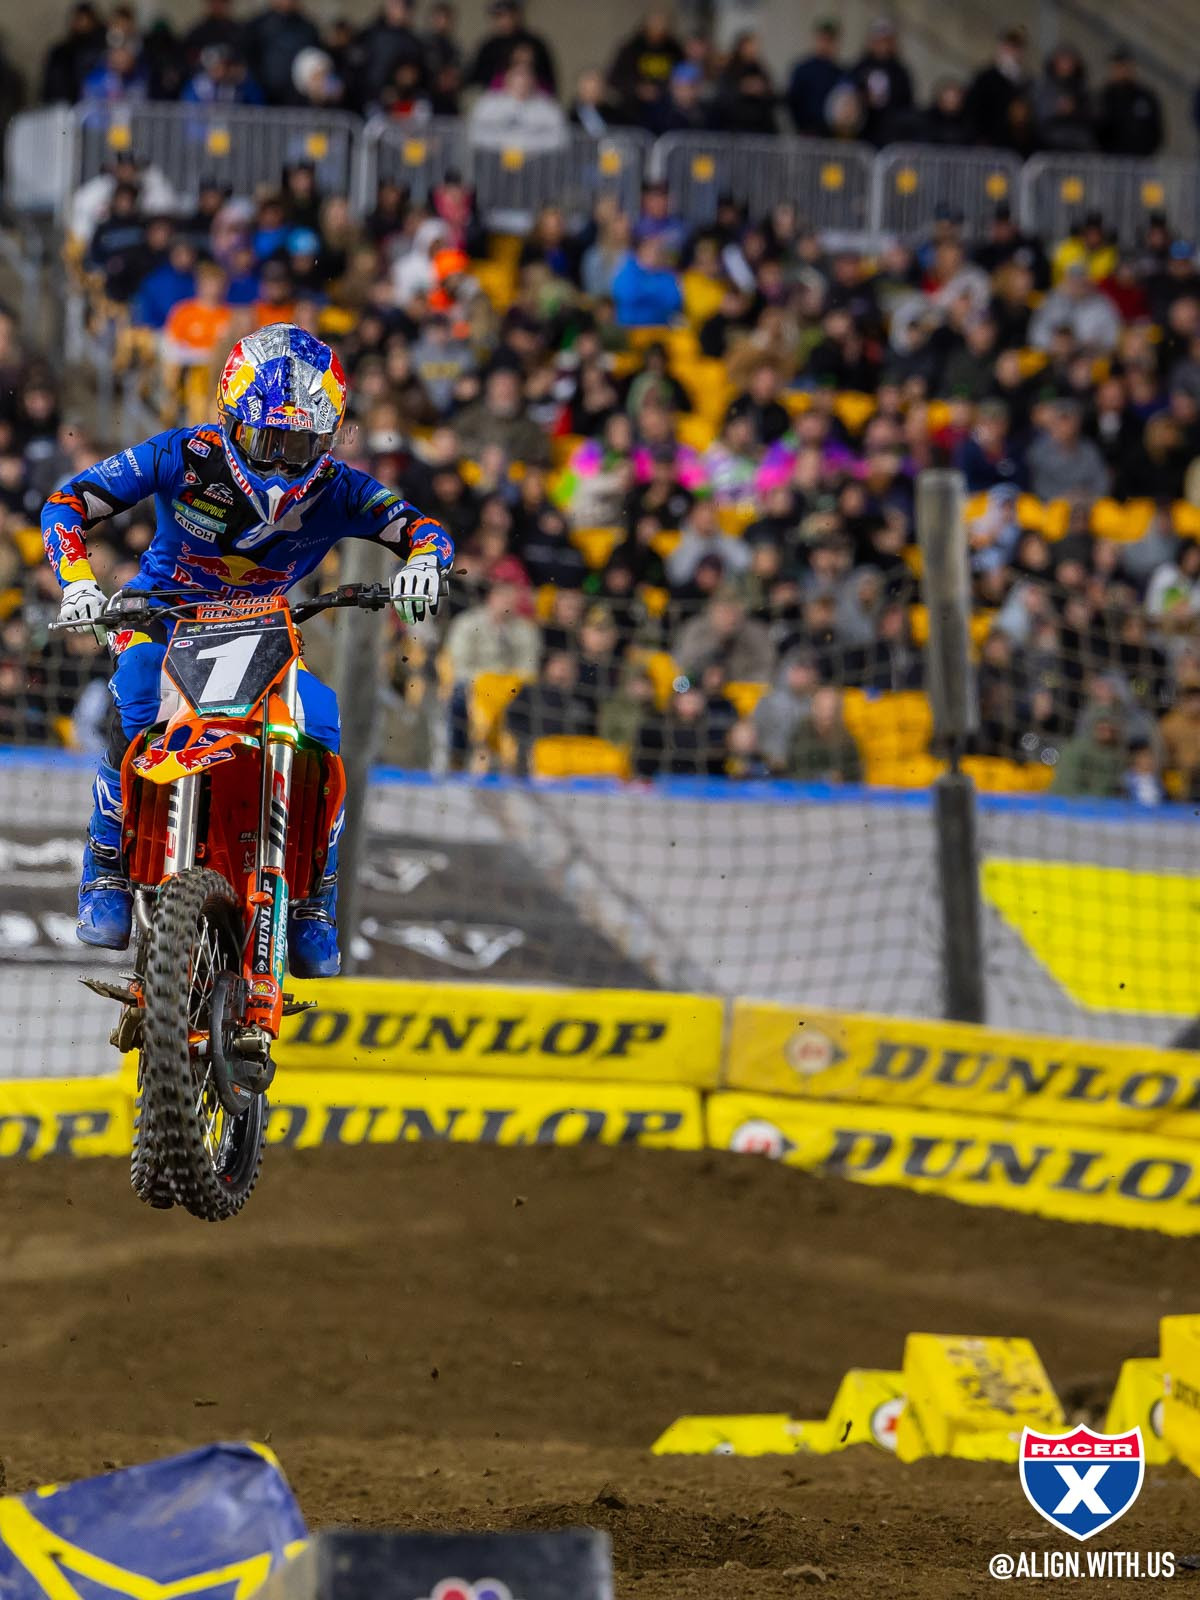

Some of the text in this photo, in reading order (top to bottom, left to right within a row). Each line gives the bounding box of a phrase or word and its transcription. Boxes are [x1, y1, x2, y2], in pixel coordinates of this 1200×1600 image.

[265, 416, 313, 429] Red Bull
[176, 514, 213, 541] AIROH
[184, 508, 221, 530] MOTOREX
[204, 620, 256, 631] SUPERCROSS
[195, 634, 263, 704] 1
[257, 879, 274, 960] DUNLP
[285, 1010, 668, 1058] DUNLOP
[862, 1040, 1200, 1112] DUNLO
[268, 1104, 685, 1147] DUNLOP
[819, 1128, 1200, 1207] DUNLO
